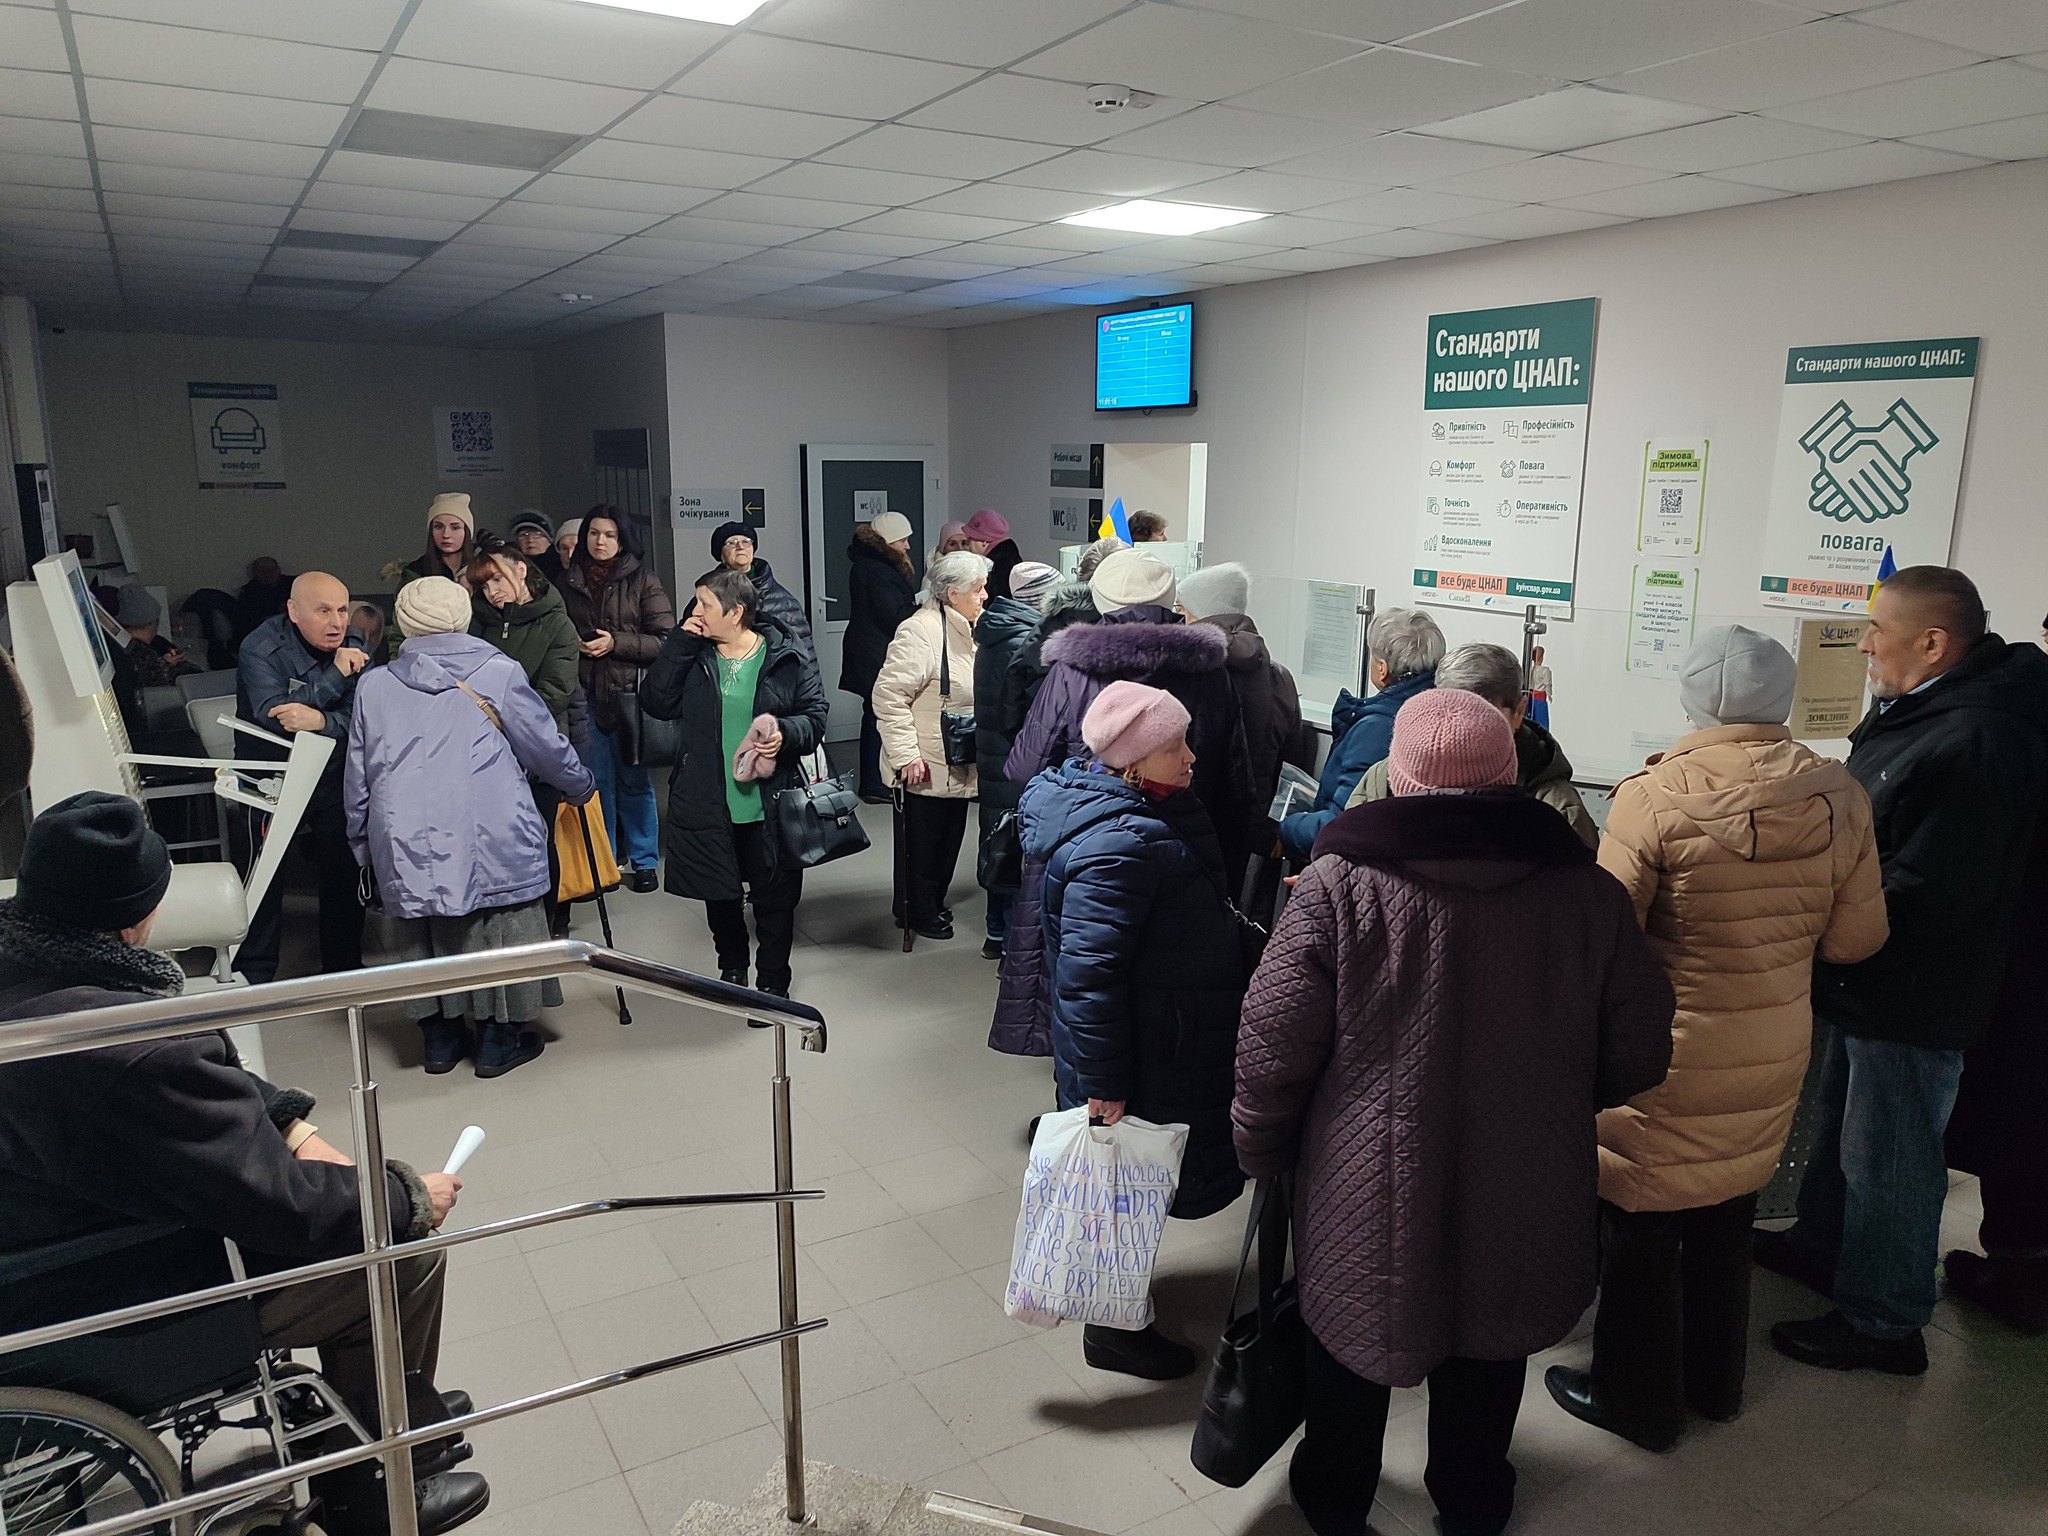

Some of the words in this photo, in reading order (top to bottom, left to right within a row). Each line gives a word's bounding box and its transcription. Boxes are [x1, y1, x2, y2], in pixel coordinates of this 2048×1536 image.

[1435, 328, 1540, 359] Стандарти
[1796, 357, 1861, 373] Стандарти
[1864, 354, 1916, 369] нашого
[1920, 349, 1966, 368] ЦНАП:
[1433, 368, 1508, 393] нашого
[1513, 357, 1580, 393] ЦНАП:
[1449, 421, 1486, 433] Привітність
[1522, 419, 1575, 432] Професійність
[1659, 452, 1692, 460] Зимова
[1446, 460, 1475, 471] Комфорт
[1519, 460, 1545, 470] Повага
[1652, 461, 1698, 469] підтримка
[679, 496, 701, 506] Зона
[1444, 498, 1470, 508] Точність
[1516, 500, 1568, 512] Оперативність
[680, 508, 730, 520] очікування
[1053, 509, 1065, 526] WC
[1441, 535, 1492, 547] Вдосконалення
[1820, 534, 1884, 552] повага
[1652, 571, 1678, 579] Зимова
[1440, 576, 1455, 586] все
[1457, 575, 1477, 590] буде
[1478, 577, 1503, 592] ЦНАП
[1647, 578, 1682, 586] підтримка
[1792, 583, 1808, 592] все
[1810, 581, 1833, 597] буде
[1835, 584, 1863, 597] ЦНАП
[1837, 628, 1859, 640] ЦНАП
[1033, 1154, 1053, 1174] AIR
[1059, 1153, 1095, 1178] LOW
[1099, 1163, 1175, 1183] TEHNOLOGY
[1064, 1269, 1101, 1299] DRY
[1016, 1287, 1118, 1323] ANATOMICAL
